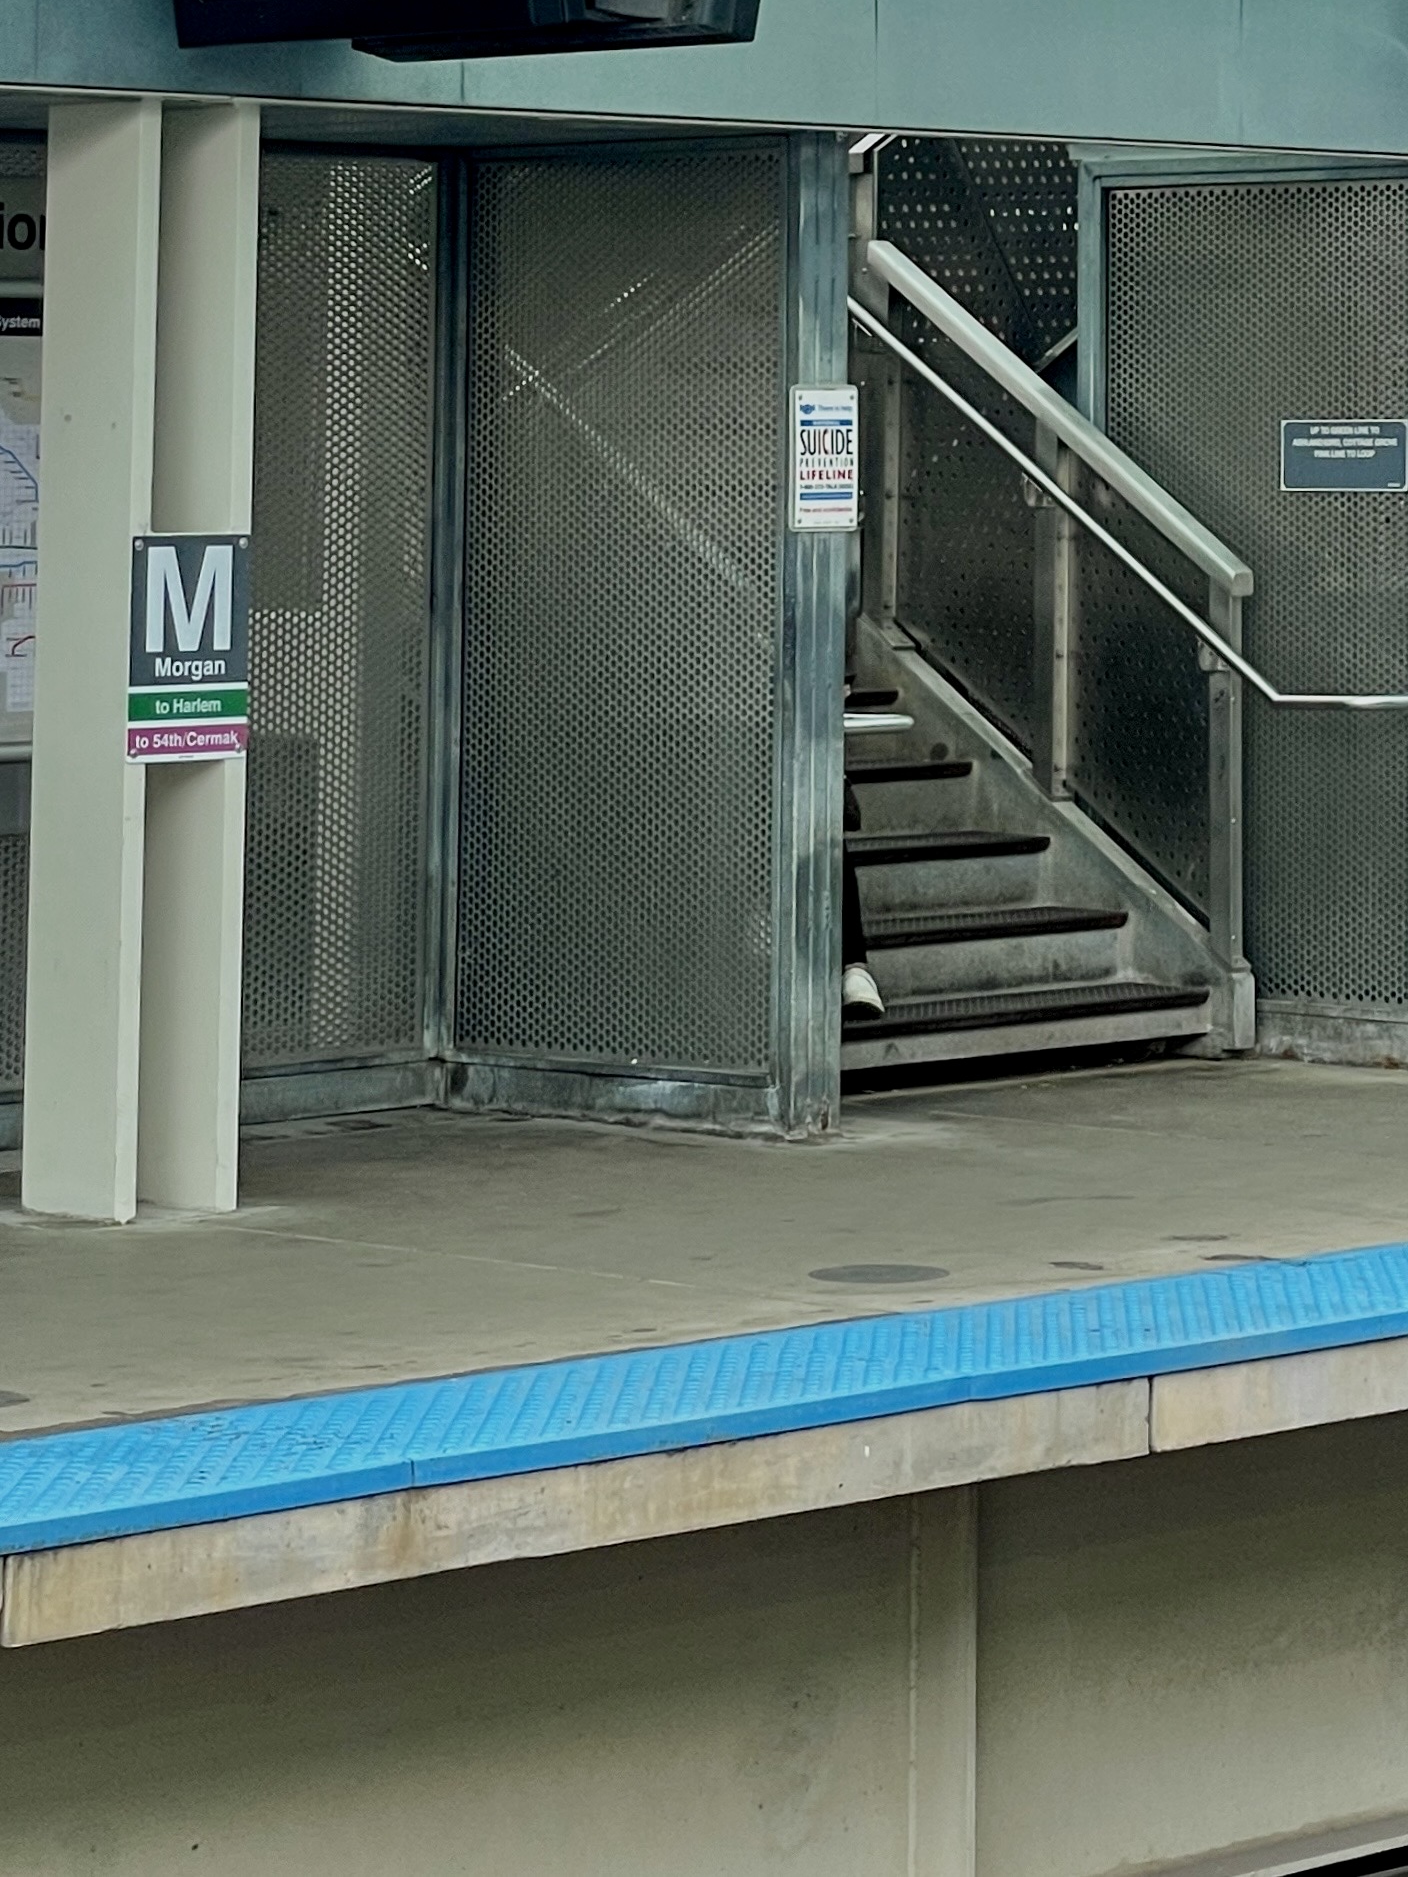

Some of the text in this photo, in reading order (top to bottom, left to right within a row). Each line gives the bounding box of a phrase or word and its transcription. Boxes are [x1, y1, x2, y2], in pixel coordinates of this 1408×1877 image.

[0, 315, 41, 332] ystem
[800, 429, 854, 456] SUICIDE
[800, 457, 854, 468] PREVENTION
[800, 470, 853, 481] LIFELINE
[145, 544, 234, 653] M
[154, 657, 226, 682] Morgan
[155, 697, 223, 715] to Harlem
[135, 730, 239, 749] to 54th/Cermak
